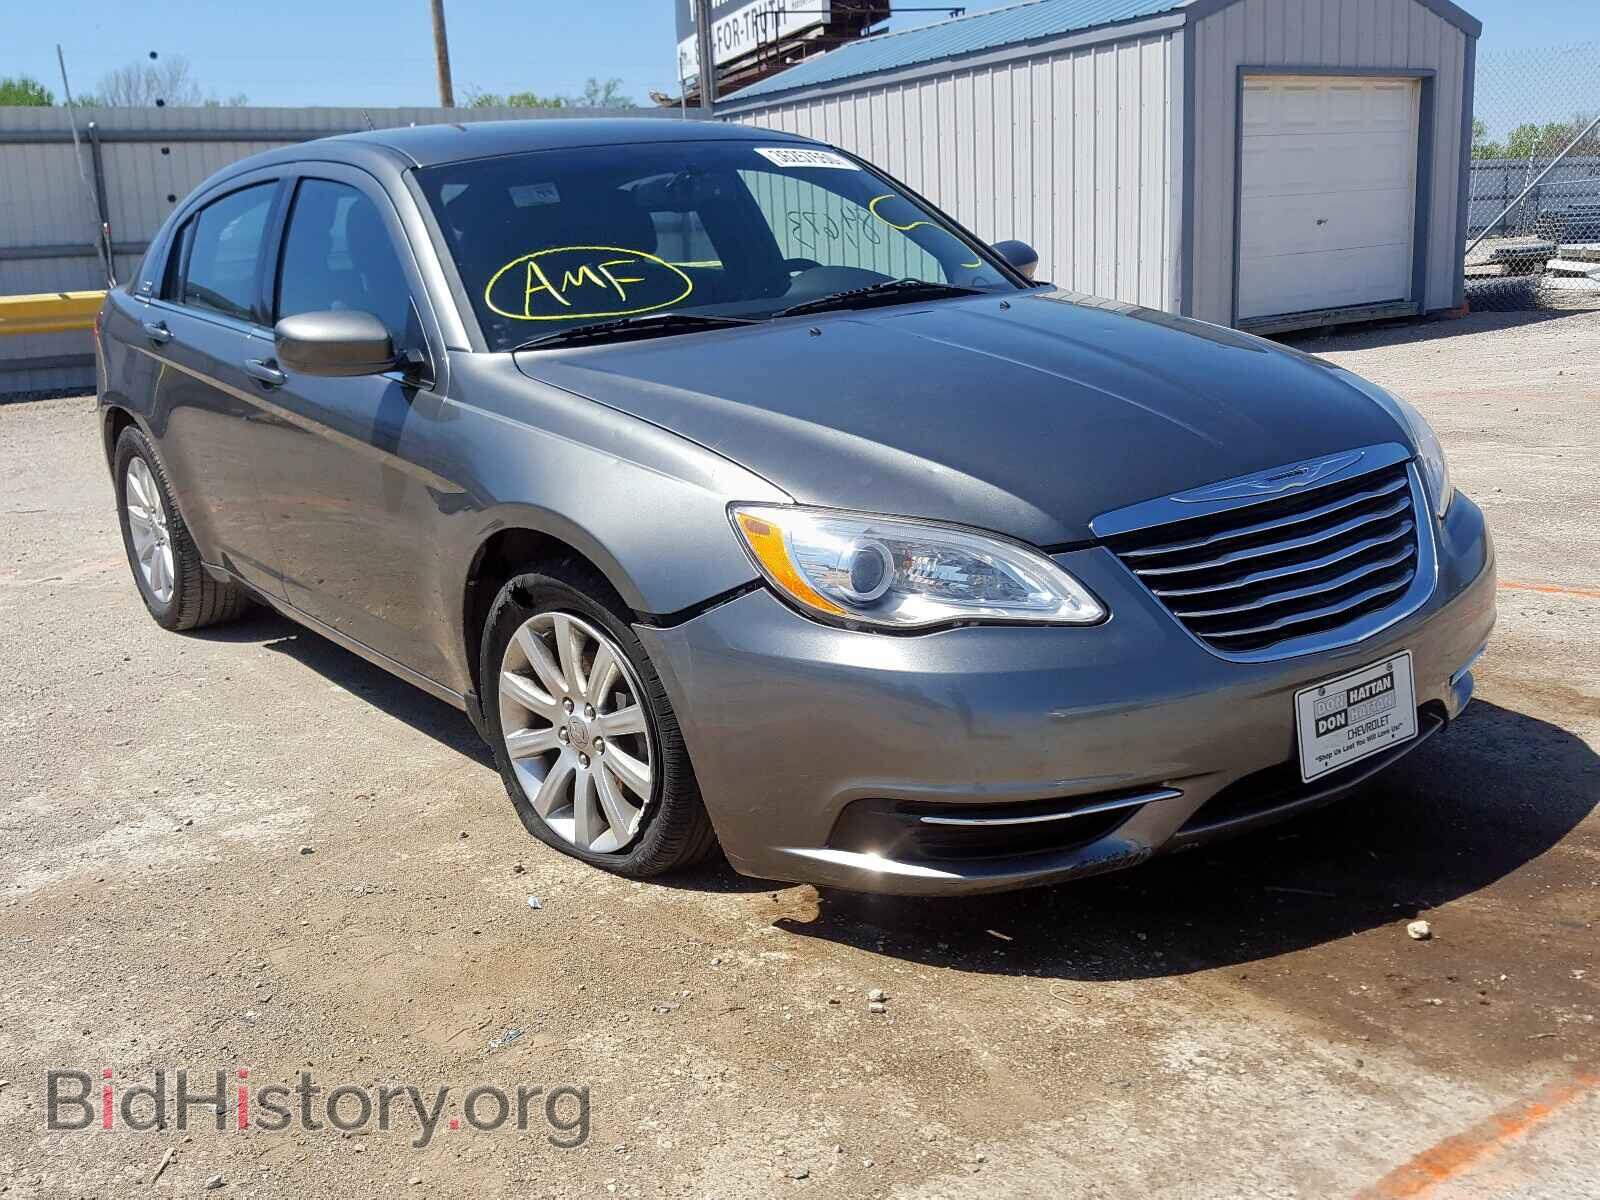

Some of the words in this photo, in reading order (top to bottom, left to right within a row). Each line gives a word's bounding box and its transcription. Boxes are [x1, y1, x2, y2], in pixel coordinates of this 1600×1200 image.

[525, 260, 645, 317] AMF
[1349, 676, 1391, 704] HATTAN
[1318, 712, 1345, 735] DON
[1347, 714, 1391, 740] CHEVROLET
